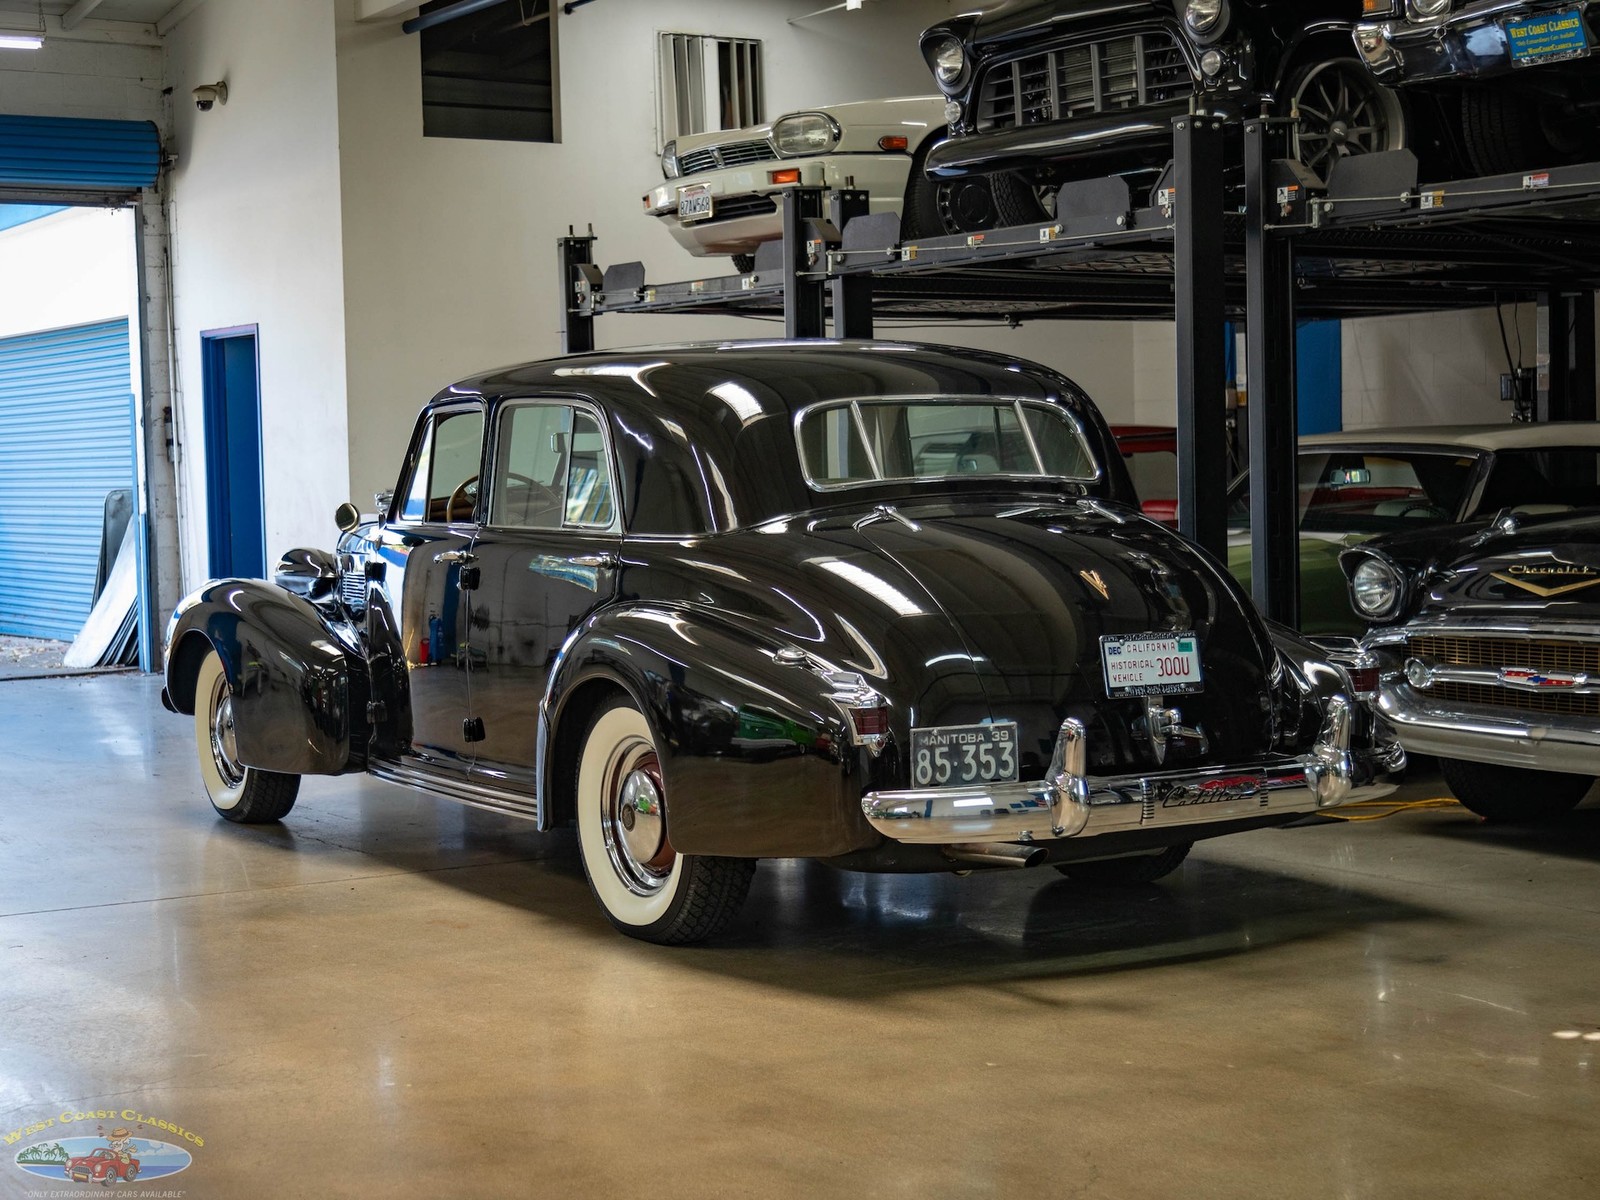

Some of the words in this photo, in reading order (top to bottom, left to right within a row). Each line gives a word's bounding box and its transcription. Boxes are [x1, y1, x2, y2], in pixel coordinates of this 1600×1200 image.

[1508, 565, 1597, 576] Chevrolet
[1108, 646, 1122, 655] DEC
[1126, 641, 1176, 654] CALIFORNIA
[1110, 659, 1155, 670] HISTORICAL
[1156, 656, 1190, 677] 300U
[1112, 672, 1143, 683] VEHICLE
[919, 733, 985, 746] MANITOBA
[991, 730, 1009, 742] 39
[1162, 784, 1253, 809] Cadillac
